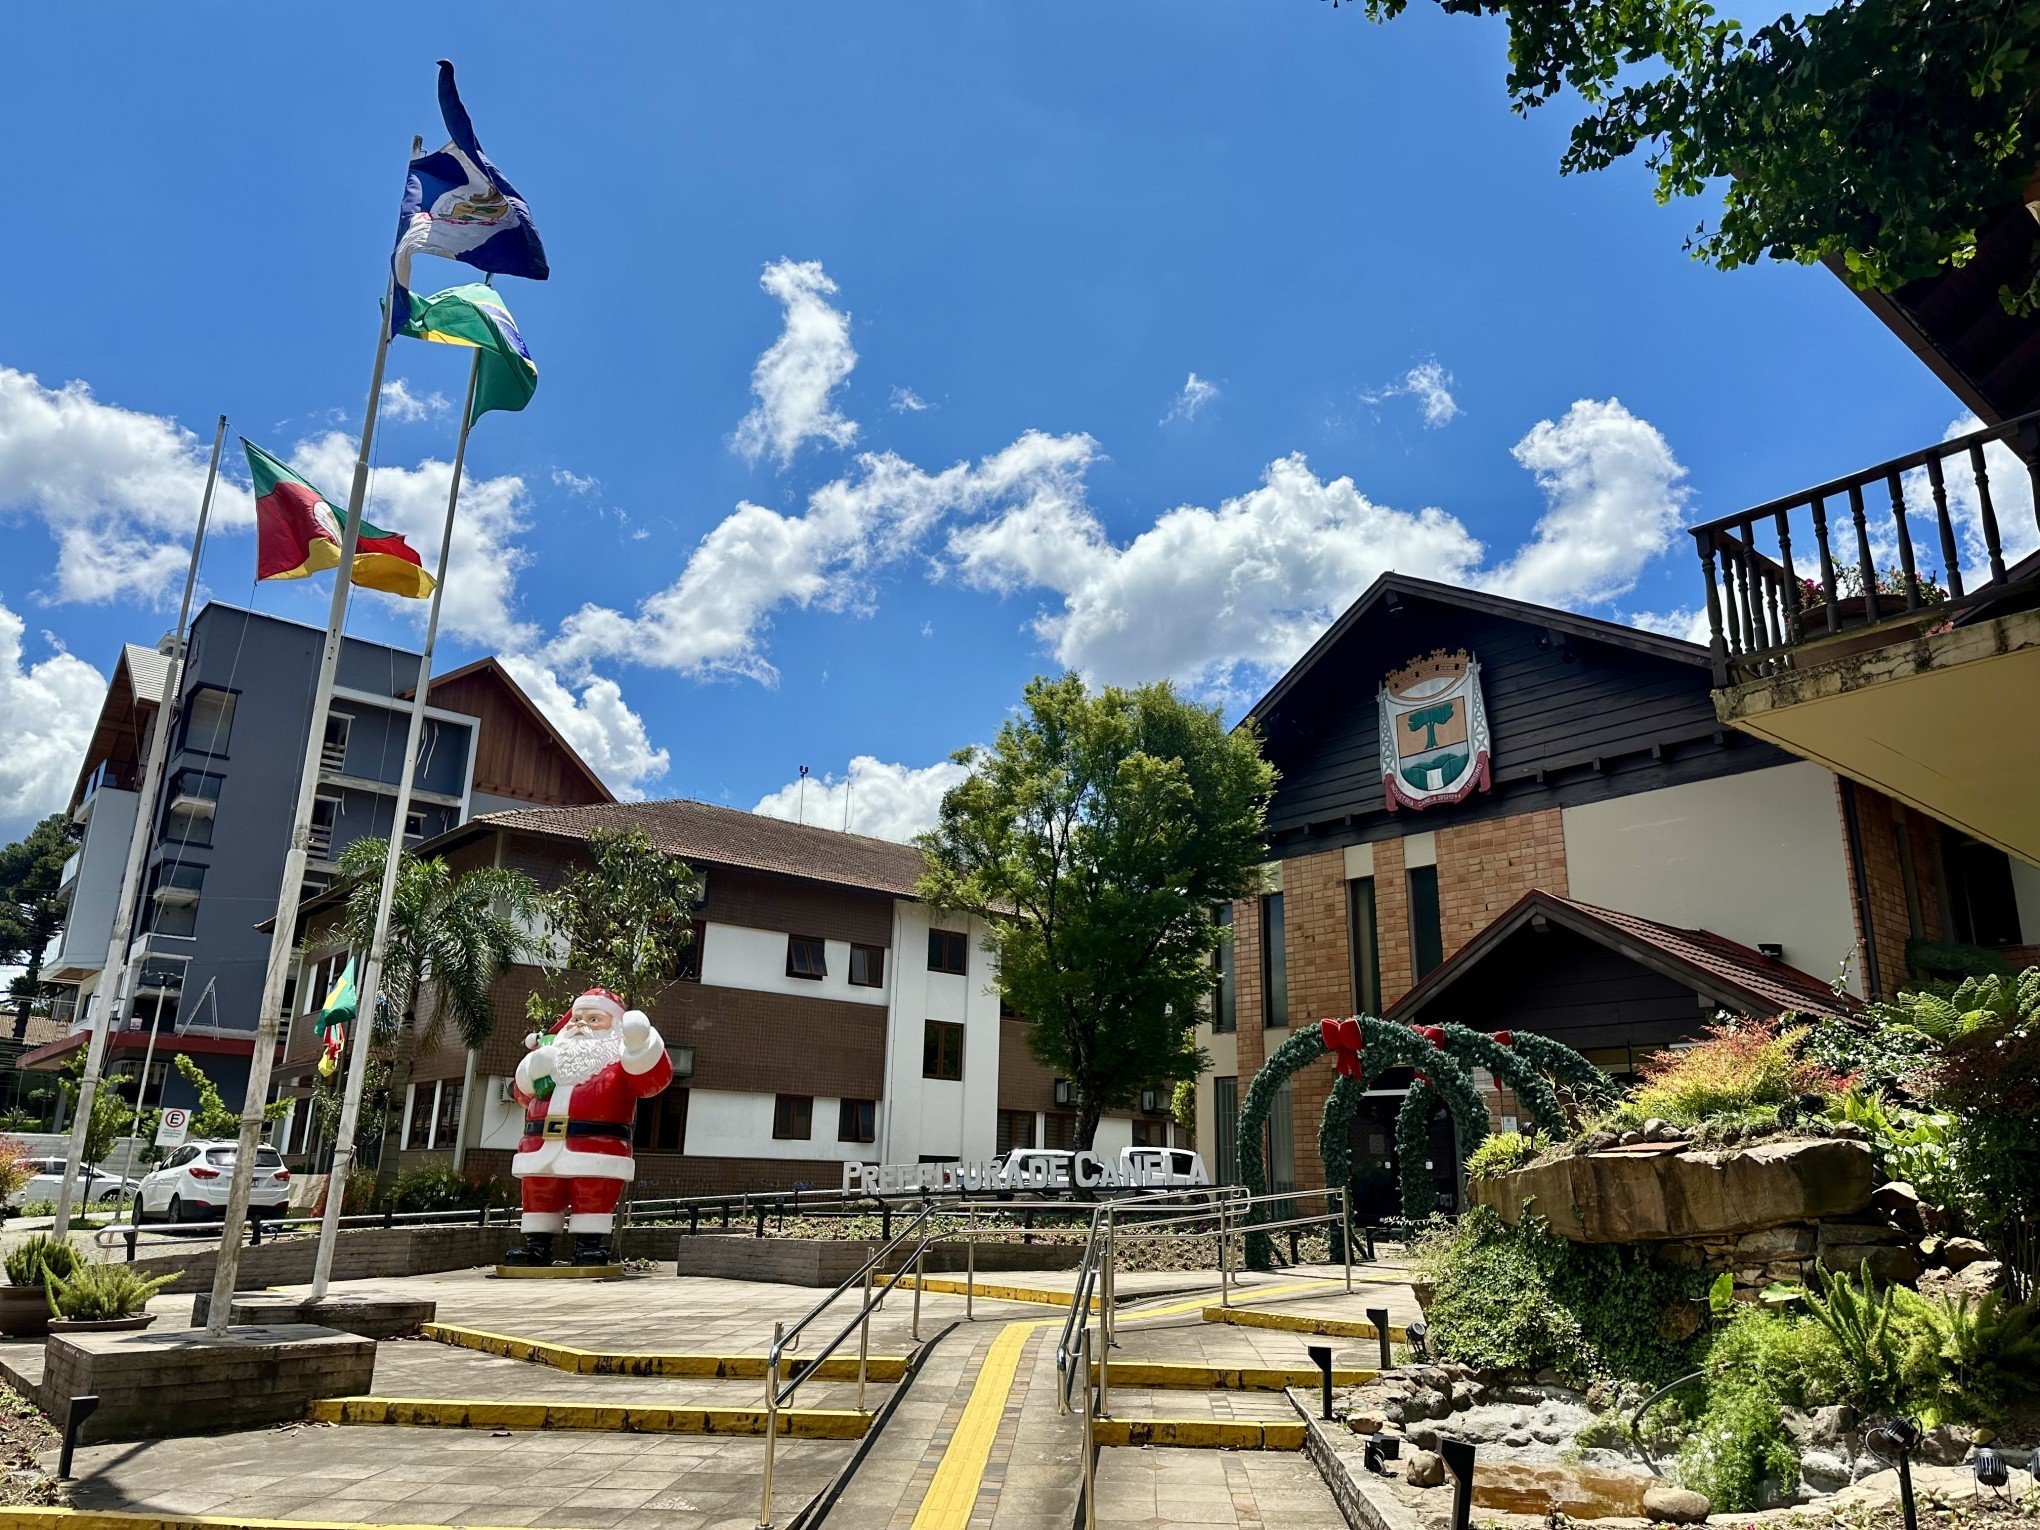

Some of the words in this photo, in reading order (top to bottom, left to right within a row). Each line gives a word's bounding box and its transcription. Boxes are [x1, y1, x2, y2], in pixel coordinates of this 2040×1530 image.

[1418, 796, 1437, 807] CANELA
[1464, 763, 1483, 789] TURISMO
[170, 1114, 180, 1124] E
[842, 1161, 1024, 1198] PREFEITURA
[1028, 1157, 1070, 1188] DE
[1075, 1150, 1210, 1188] CANELA
